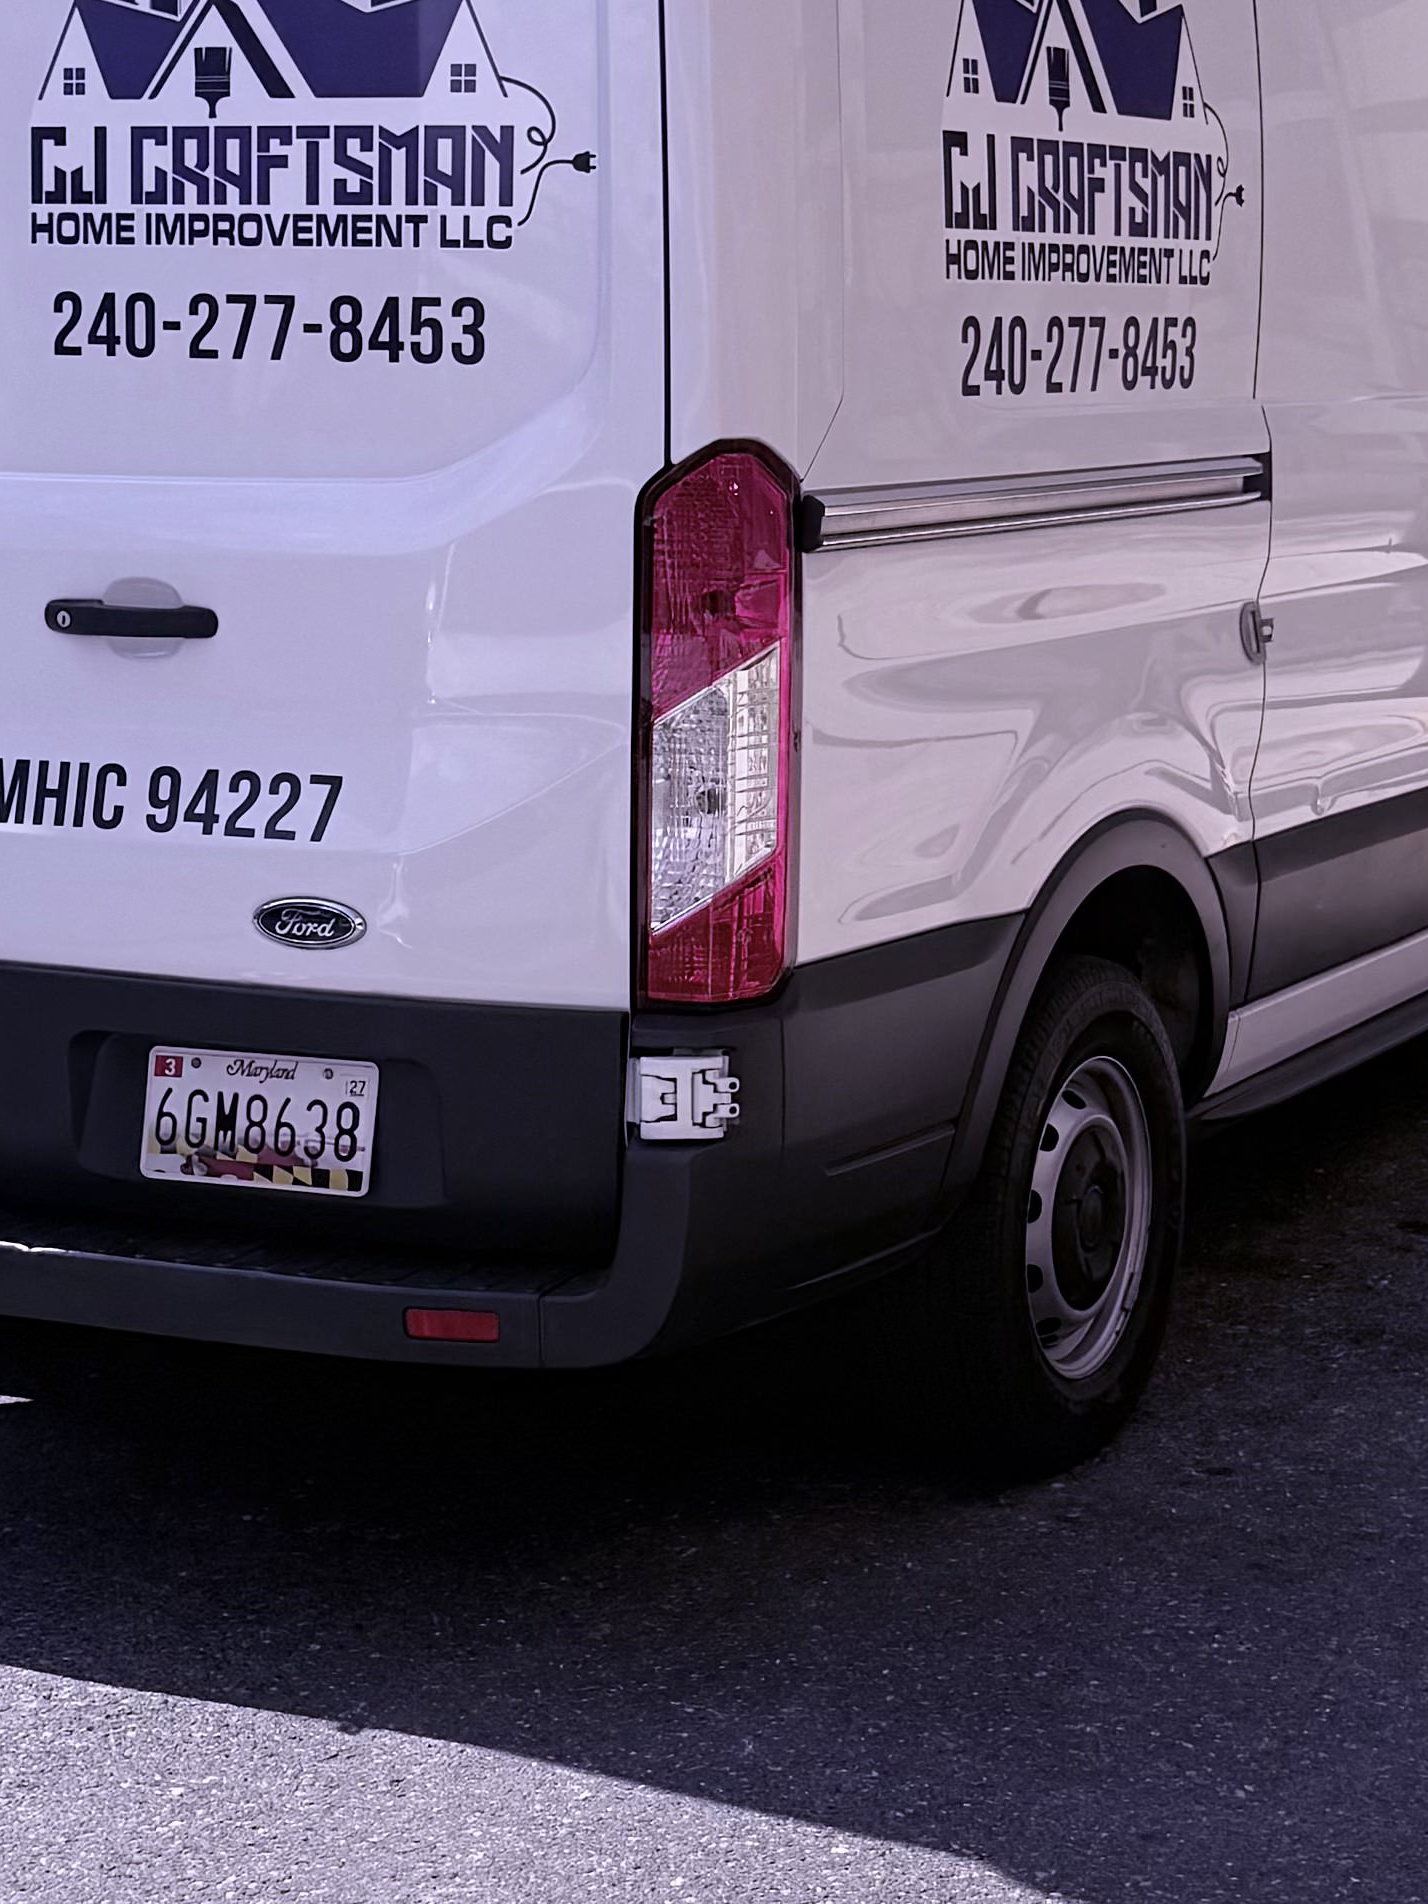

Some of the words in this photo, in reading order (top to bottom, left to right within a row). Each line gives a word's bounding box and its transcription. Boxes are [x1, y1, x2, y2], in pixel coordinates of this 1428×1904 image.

[31, 126, 107, 204] CJ
[131, 125, 514, 206] CRAFTSMAN
[942, 130, 997, 230] CJ
[1010, 136, 1212, 241] CRAFTSMAN
[31, 213, 135, 245] HOME
[145, 213, 427, 247] IMPROVEMENT
[439, 215, 513, 249] LLC
[945, 239, 1015, 281] HOME
[1022, 242, 1174, 284] IMPROVEMENT
[1179, 248, 1211, 285] LLC
[53, 291, 486, 364] 240-277-8453
[961, 315, 1197, 396] 240-277-8453
[145, 766, 343, 842] 94227
[275, 908, 336, 936] Ford
[165, 1058, 176, 1076] 3
[226, 1059, 298, 1083] Maryland
[155, 1087, 360, 1162] 6GM8638
